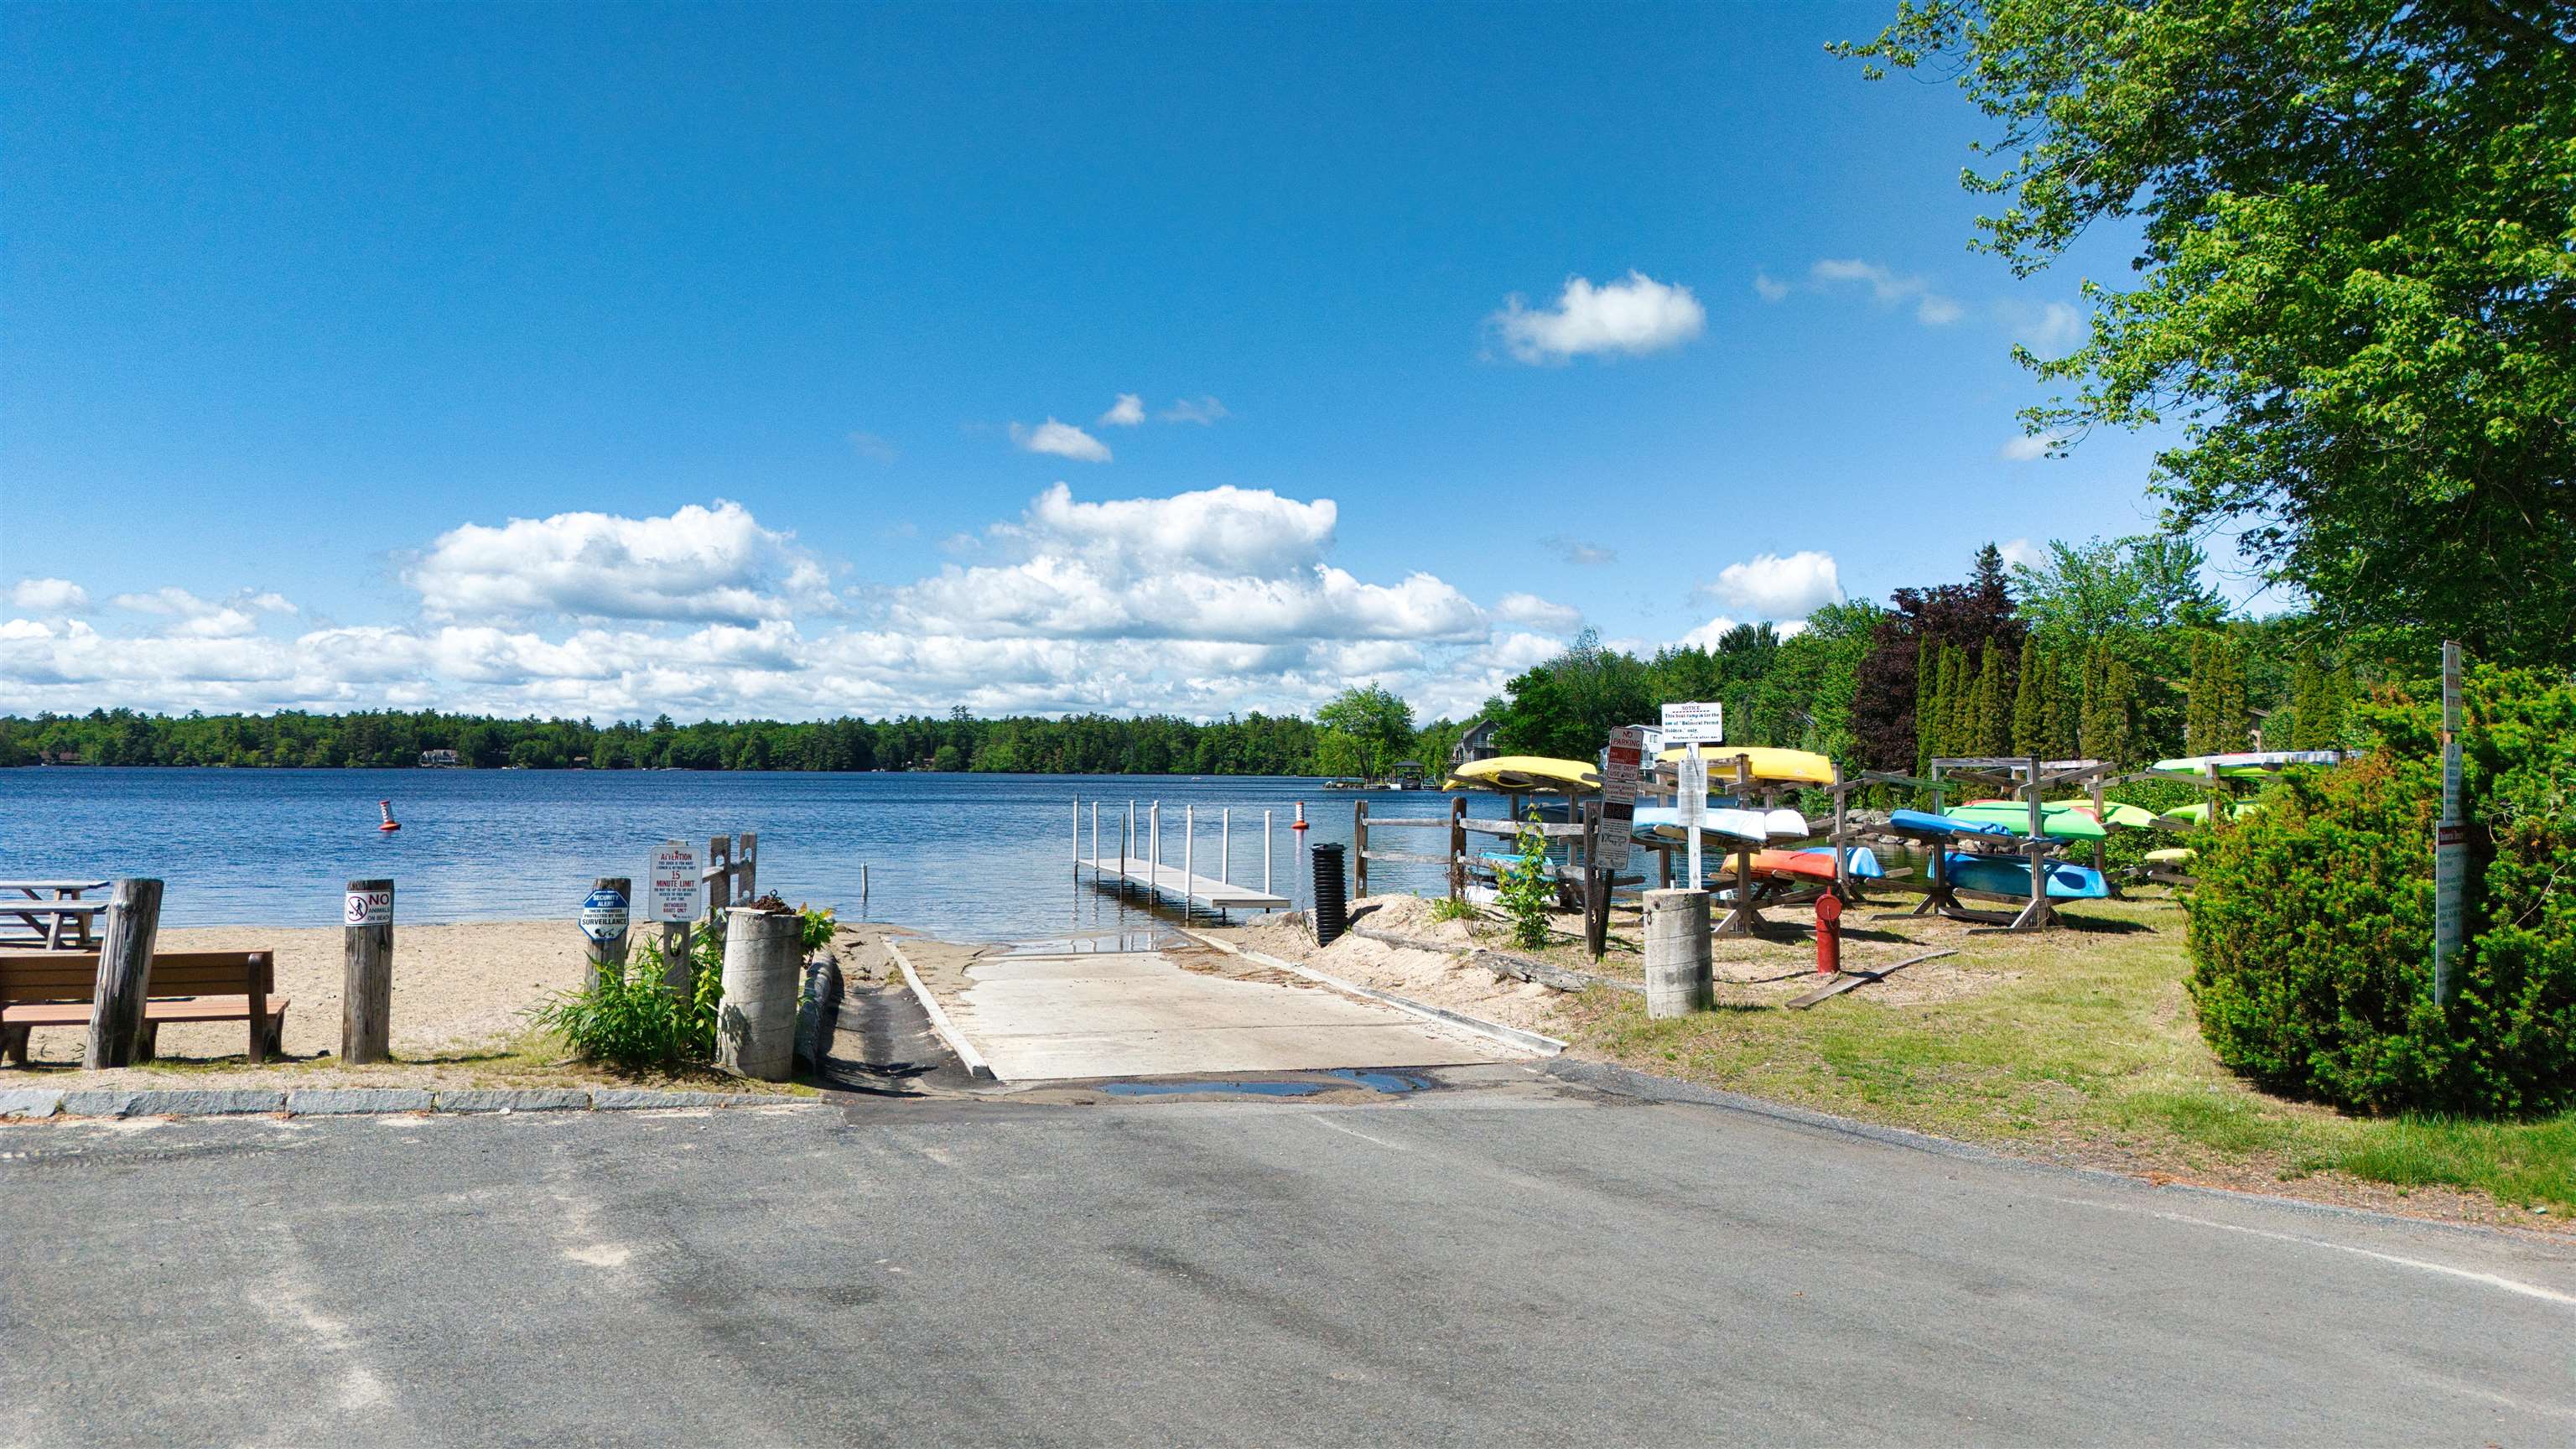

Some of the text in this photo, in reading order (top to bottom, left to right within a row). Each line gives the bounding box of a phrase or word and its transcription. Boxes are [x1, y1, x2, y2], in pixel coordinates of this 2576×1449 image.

[1623, 730, 1633, 739] NO
[1613, 738, 1640, 747] PARKING
[672, 870, 681, 880] 15
[369, 894, 389, 905] NO
